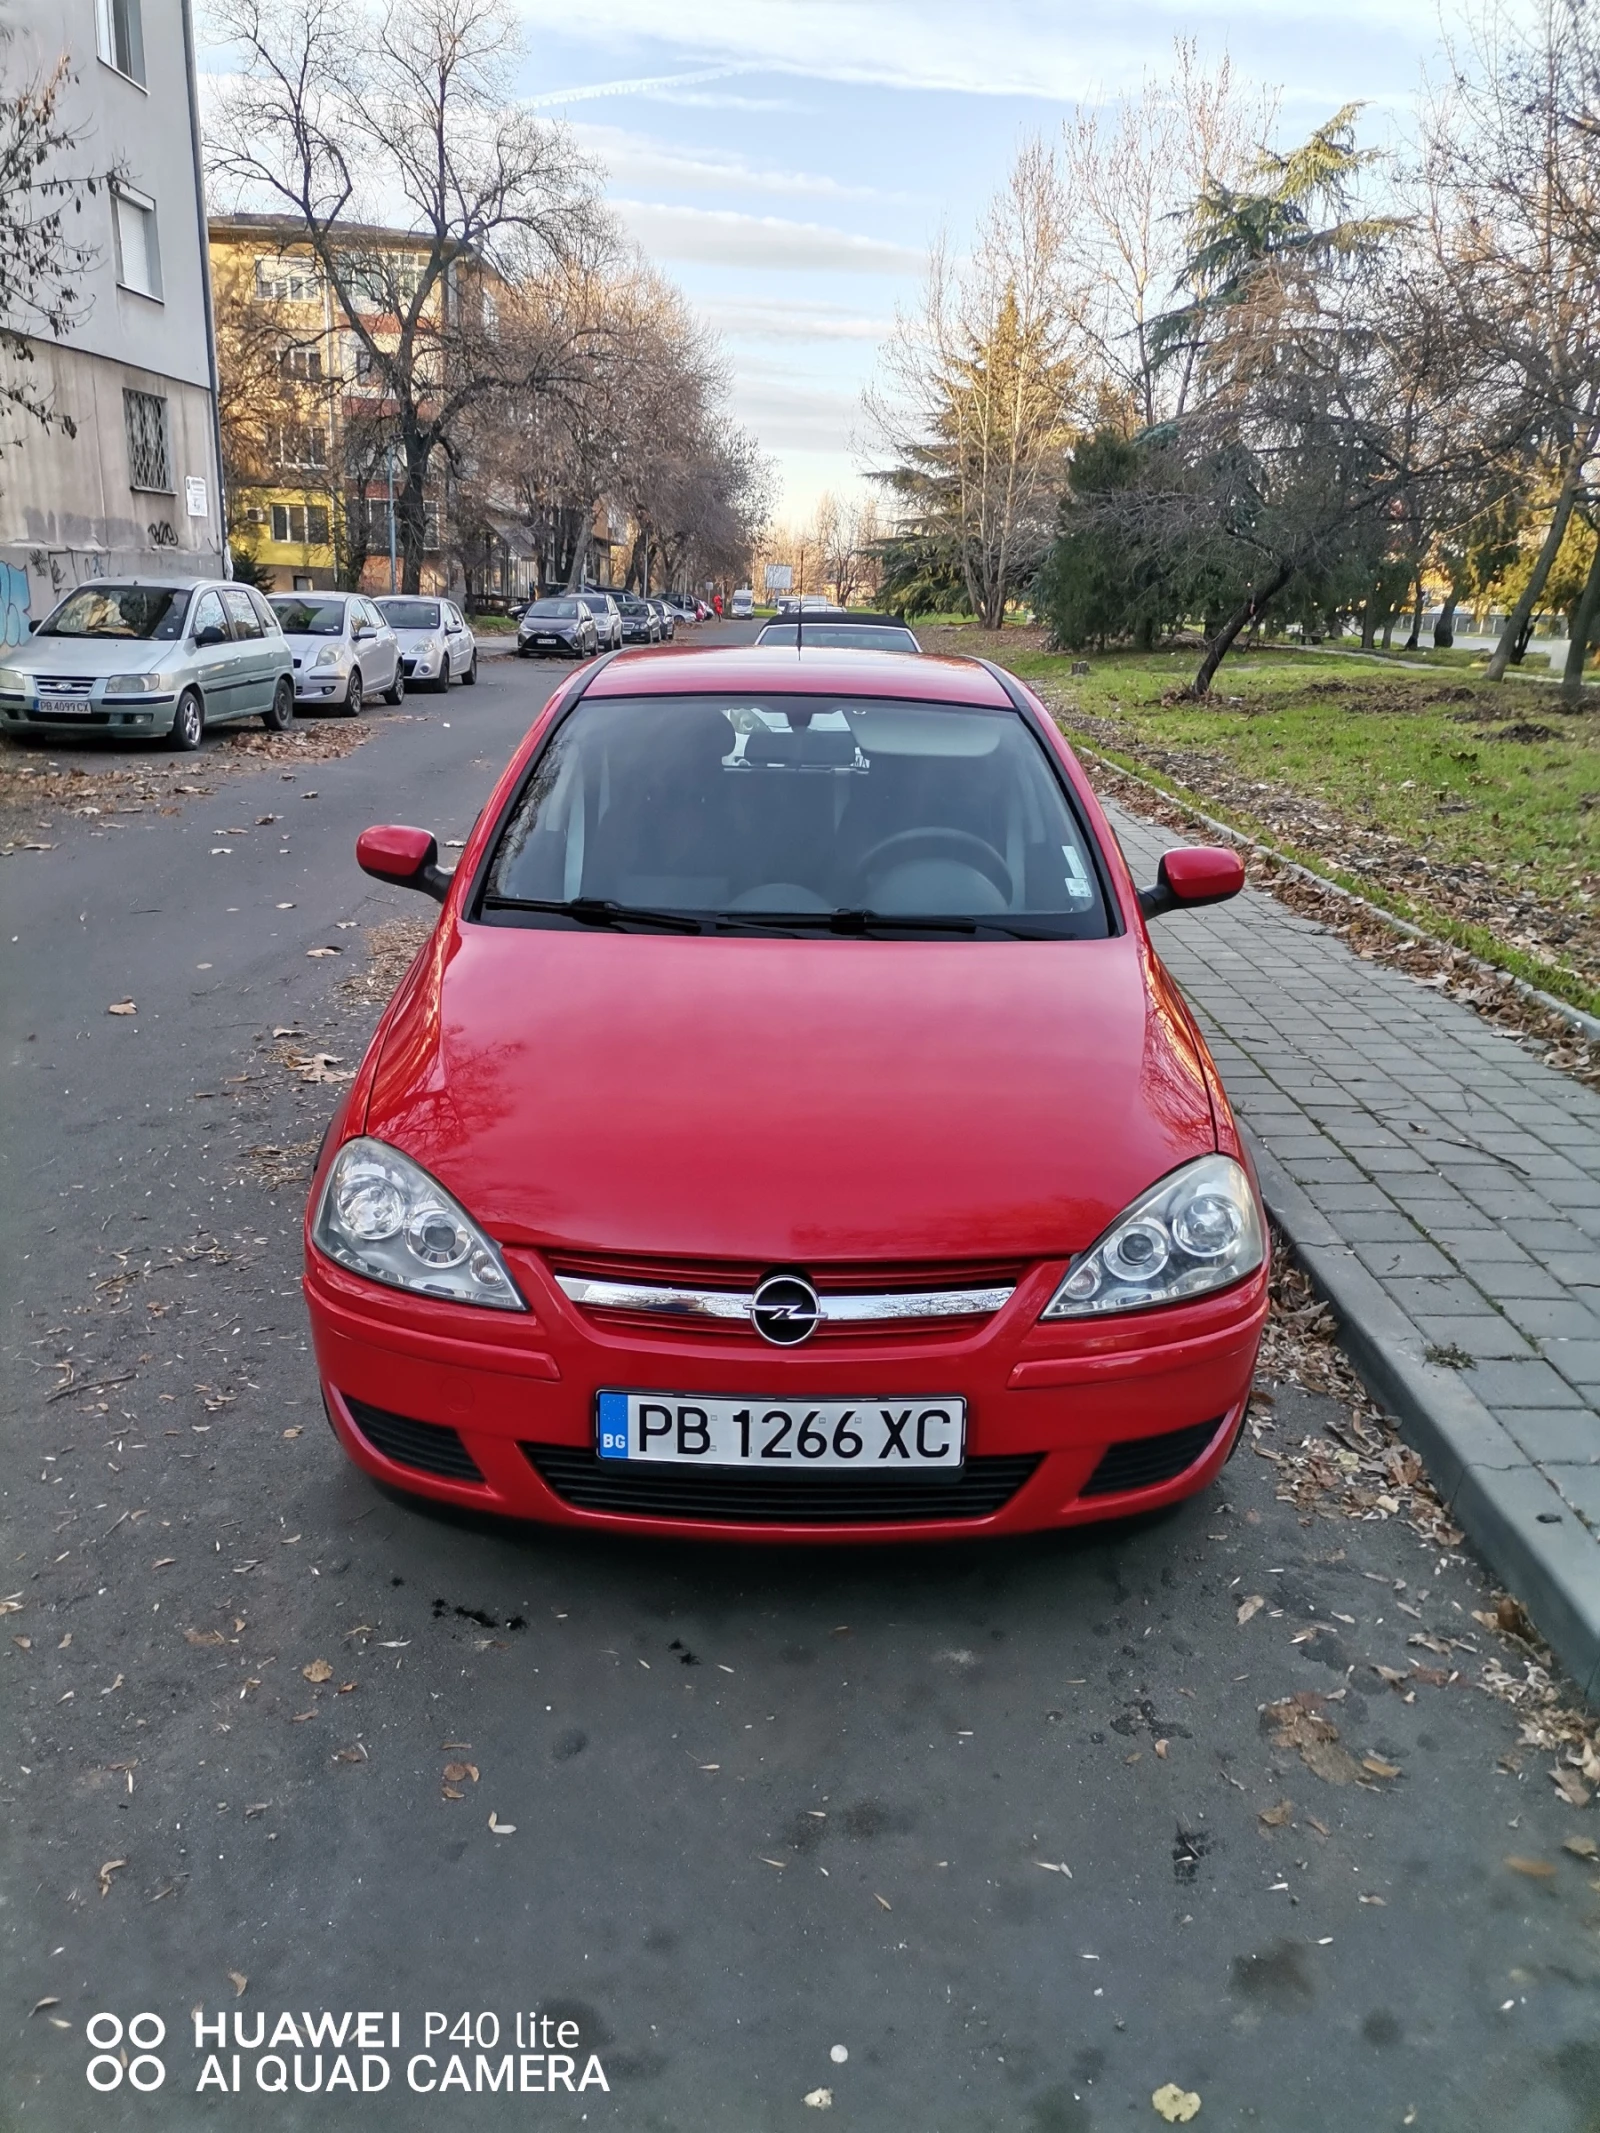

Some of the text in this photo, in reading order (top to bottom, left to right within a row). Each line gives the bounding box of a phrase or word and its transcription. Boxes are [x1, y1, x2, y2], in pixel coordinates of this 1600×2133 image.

[40, 701, 53, 711] PB
[602, 1403, 951, 1459] BG PB 1266 XC
